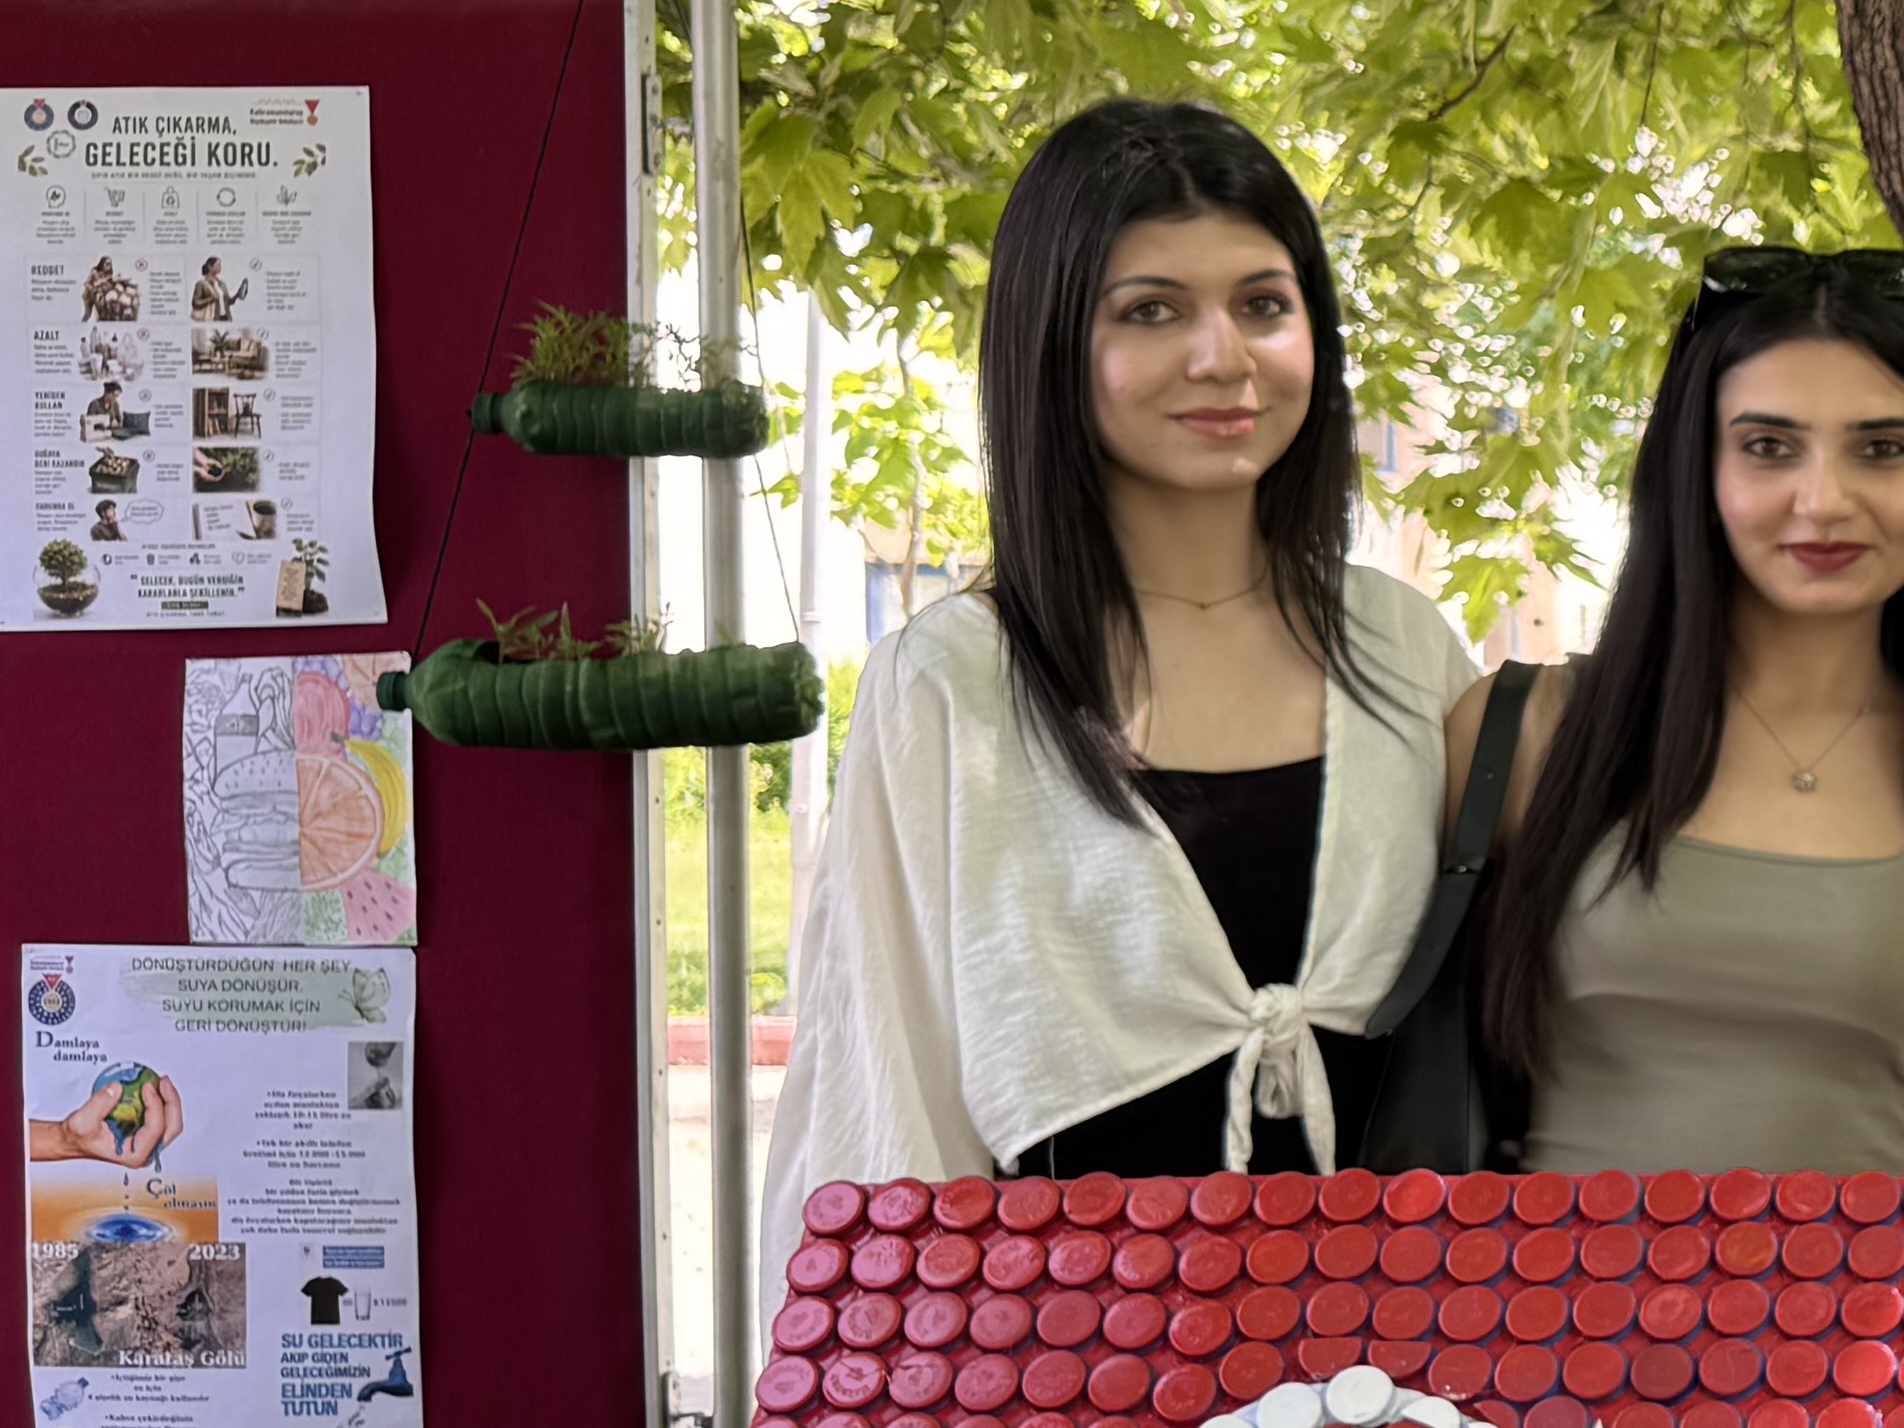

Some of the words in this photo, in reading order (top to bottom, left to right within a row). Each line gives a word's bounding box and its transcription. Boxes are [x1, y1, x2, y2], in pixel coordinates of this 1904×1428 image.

[112, 116, 148, 134] ATIK
[155, 116, 236, 138] ÇIKARMA,
[85, 136, 196, 167] GELECEĞİ
[207, 141, 278, 167] KORU.
[132, 957, 274, 973] DÖNÜŞTÜRDÜĞÜN
[283, 961, 315, 972] HER
[321, 960, 351, 975] ŞEY
[178, 979, 217, 992] SUYA
[162, 999, 202, 1012] SUYU
[208, 1000, 284, 1012] KORUMAK
[290, 998, 320, 1015] İÇİN
[175, 1018, 211, 1032] GERİ
[36, 1031, 100, 1051] Damlaya
[53, 1049, 107, 1065] damlaya
[31, 1242, 79, 1260] 1985
[189, 1243, 240, 1260] 2023
[281, 1333, 303, 1348] SU
[308, 1329, 403, 1348] GELECEKTİR
[119, 1350, 194, 1369] Karataş
[200, 1349, 245, 1367] Gölü
[281, 1352, 309, 1364] AKIP
[311, 1350, 348, 1364] GİDEN
[281, 1364, 370, 1378] GELECEĞİMİZİN
[281, 1380, 352, 1399] ELİNDEN
[281, 1400, 338, 1416] TUTUN
